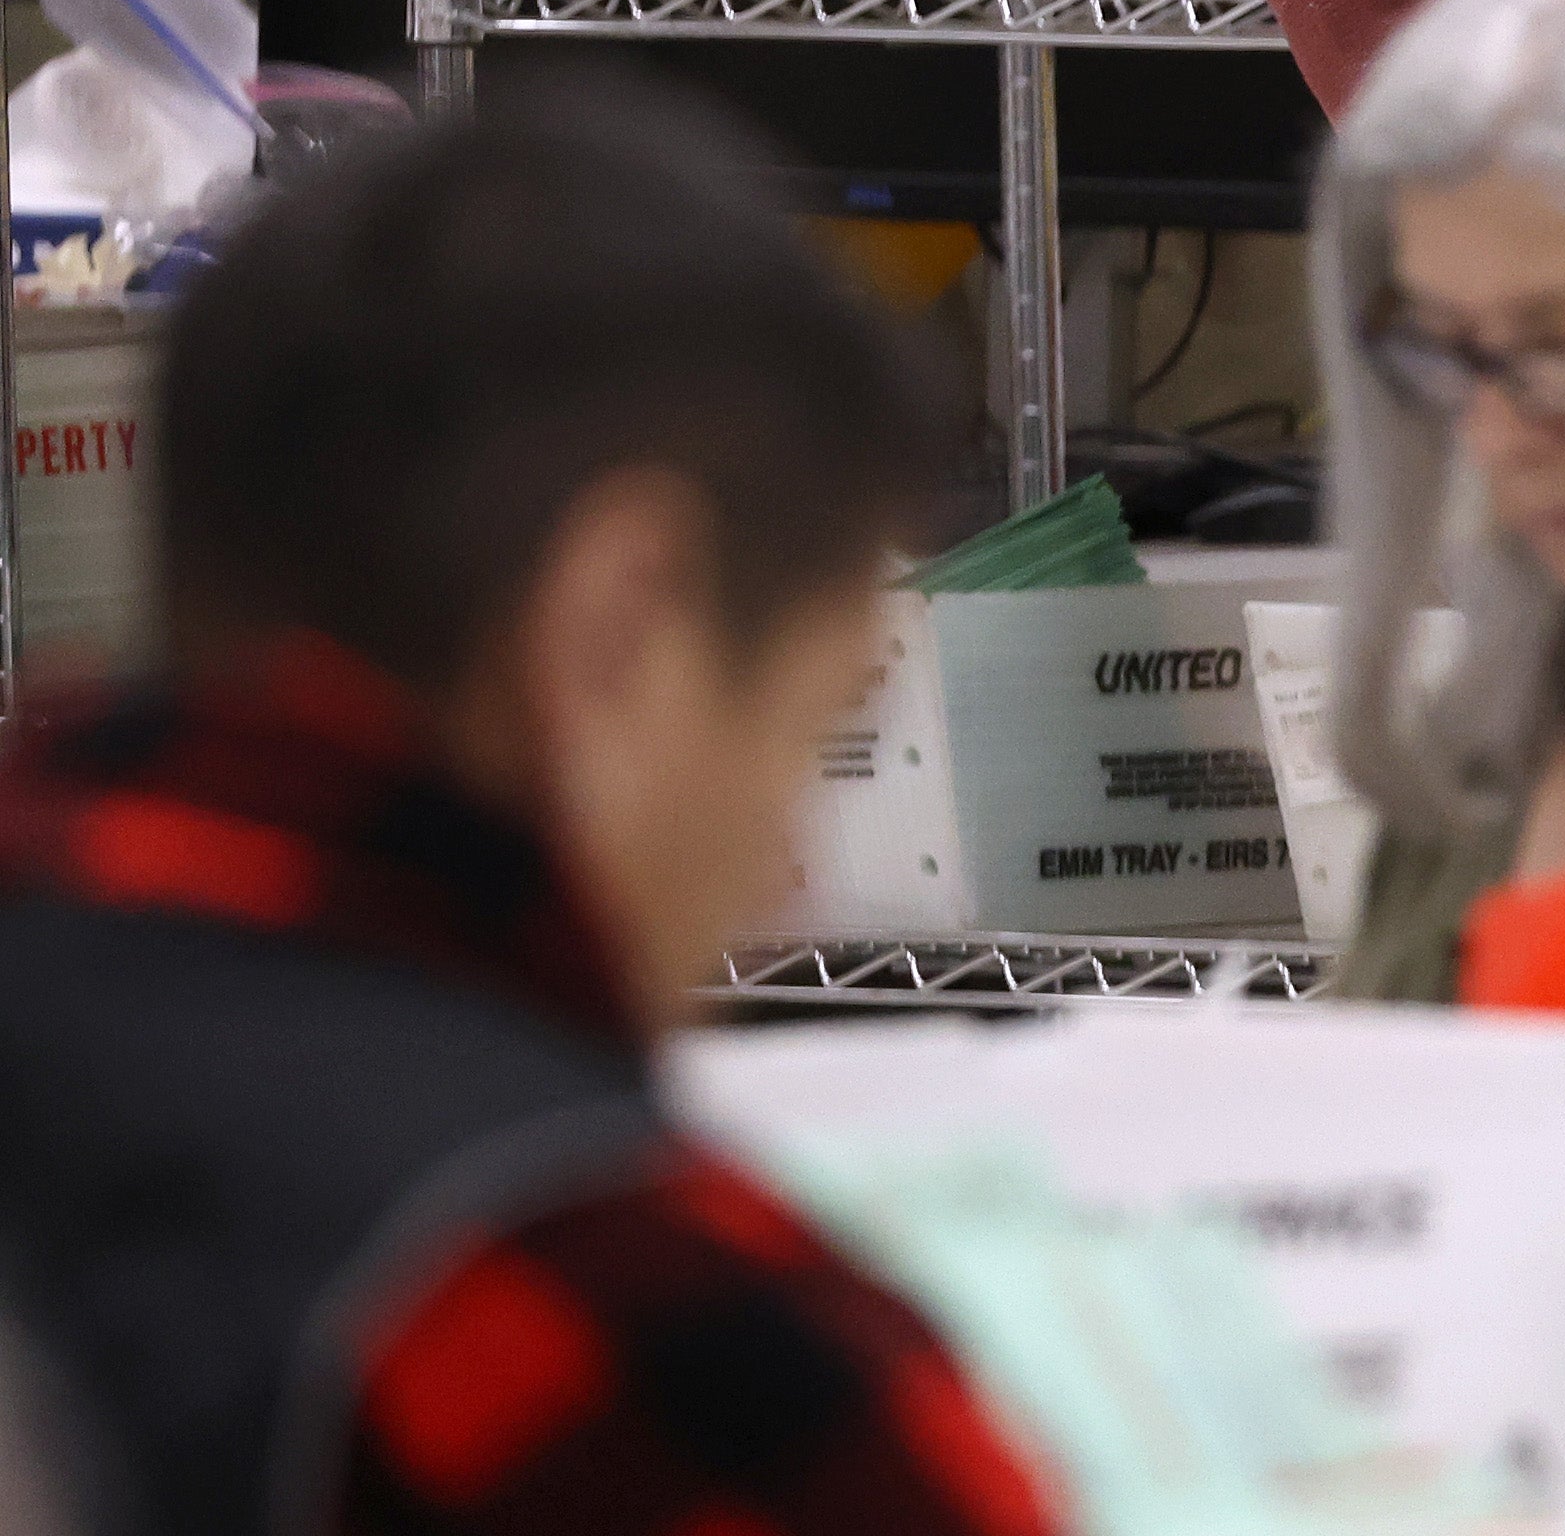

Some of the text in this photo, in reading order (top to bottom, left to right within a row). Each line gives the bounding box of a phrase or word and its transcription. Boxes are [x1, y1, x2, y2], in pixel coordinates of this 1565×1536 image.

[18, 419, 138, 477] PERTY
[1095, 647, 1243, 694] UNITED
[1039, 846, 1103, 880] EMM
[1112, 841, 1182, 876] TRAY
[1205, 837, 1269, 872] EIRS
